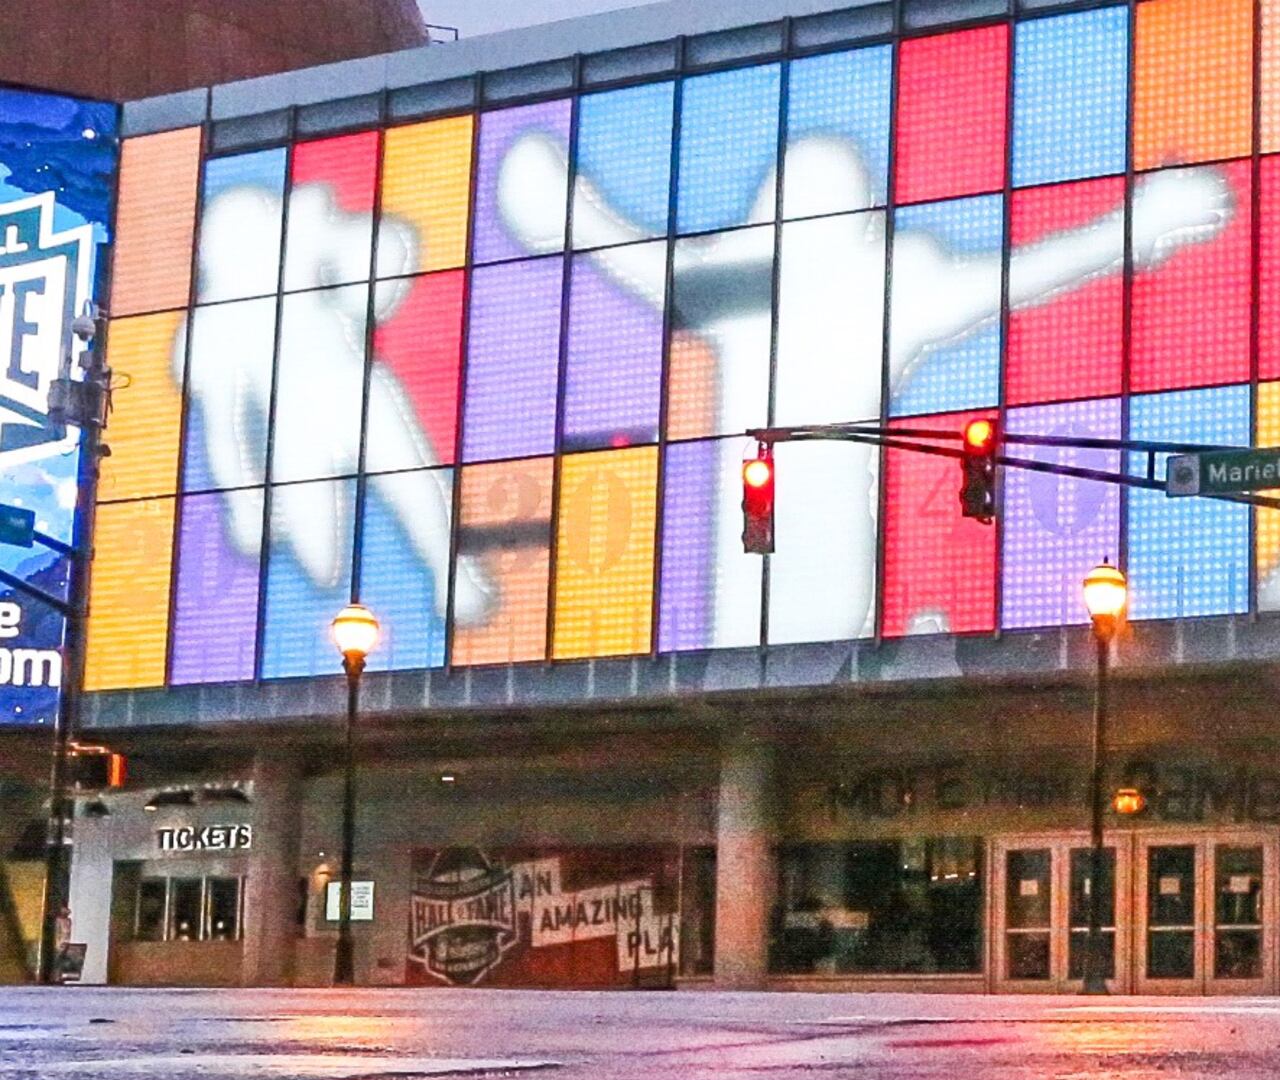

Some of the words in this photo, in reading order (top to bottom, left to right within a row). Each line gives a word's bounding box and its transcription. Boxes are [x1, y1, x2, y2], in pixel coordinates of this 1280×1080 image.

[157, 824, 252, 850] TICKETS
[519, 870, 552, 899] AN
[540, 893, 643, 933] AMAZING
